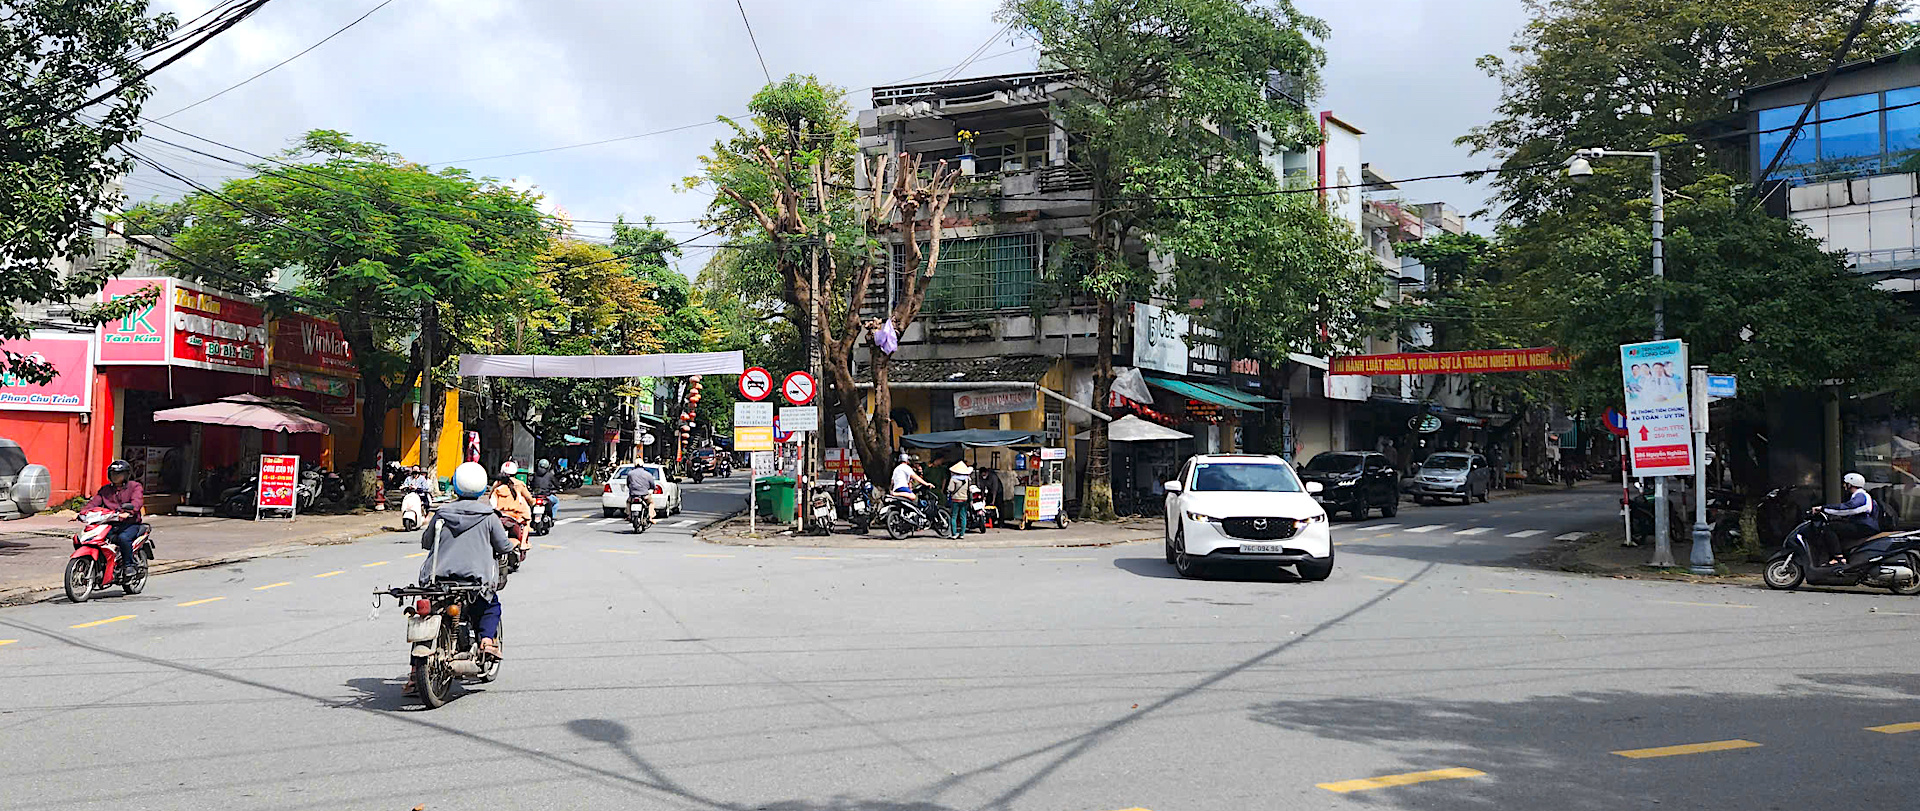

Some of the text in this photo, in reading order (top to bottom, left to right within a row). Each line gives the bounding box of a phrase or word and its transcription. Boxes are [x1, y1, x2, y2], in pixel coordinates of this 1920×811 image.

[105, 334, 161, 343] Tân Kim
[1345, 358, 1364, 372] HÀNH
[1365, 357, 1382, 374] LUẬT
[1384, 356, 1406, 371] NGHĨA
[1407, 358, 1417, 373] VỤ
[1418, 355, 1439, 371] QUÂN
[1440, 356, 1451, 371] SỰ
[1452, 354, 1462, 369] LÀ
[1463, 354, 1488, 369] TRÁCH
[1490, 352, 1515, 370] NHIỆM
[1517, 352, 1528, 366] VÀ
[0, 394, 78, 404] Phan Chu Trinh
